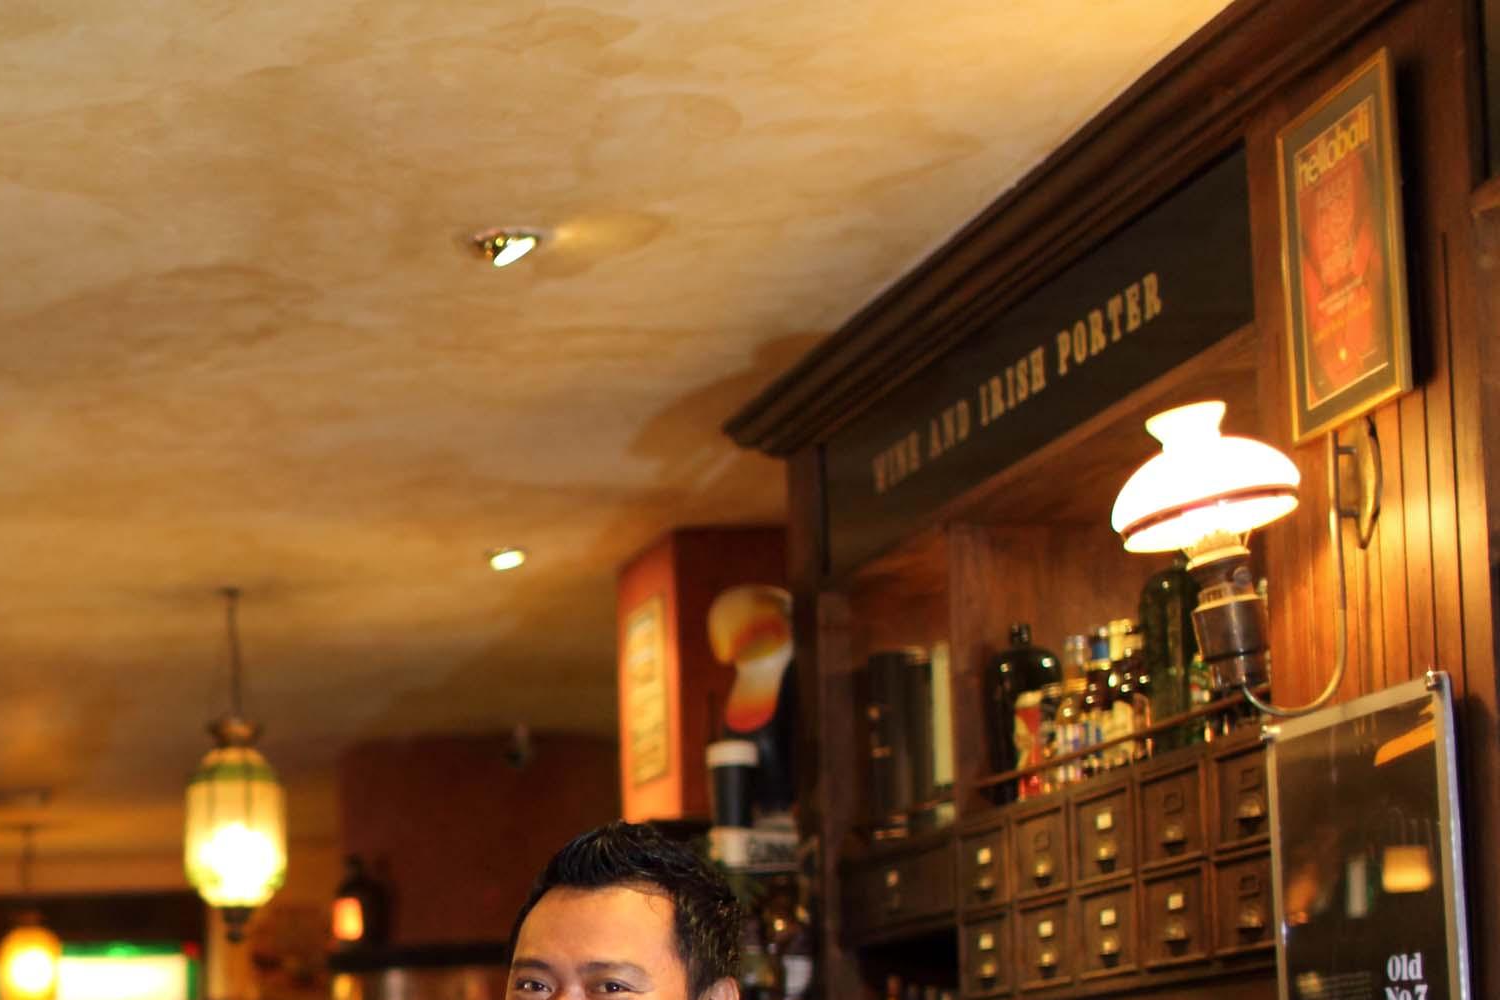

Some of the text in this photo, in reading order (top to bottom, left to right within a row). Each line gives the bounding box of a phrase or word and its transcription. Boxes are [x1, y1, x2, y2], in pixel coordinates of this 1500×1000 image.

[928, 399, 970, 459] AND
[979, 346, 1046, 426] IRISH
[1057, 272, 1162, 376] PORTER
[1387, 952, 1423, 981] Old
